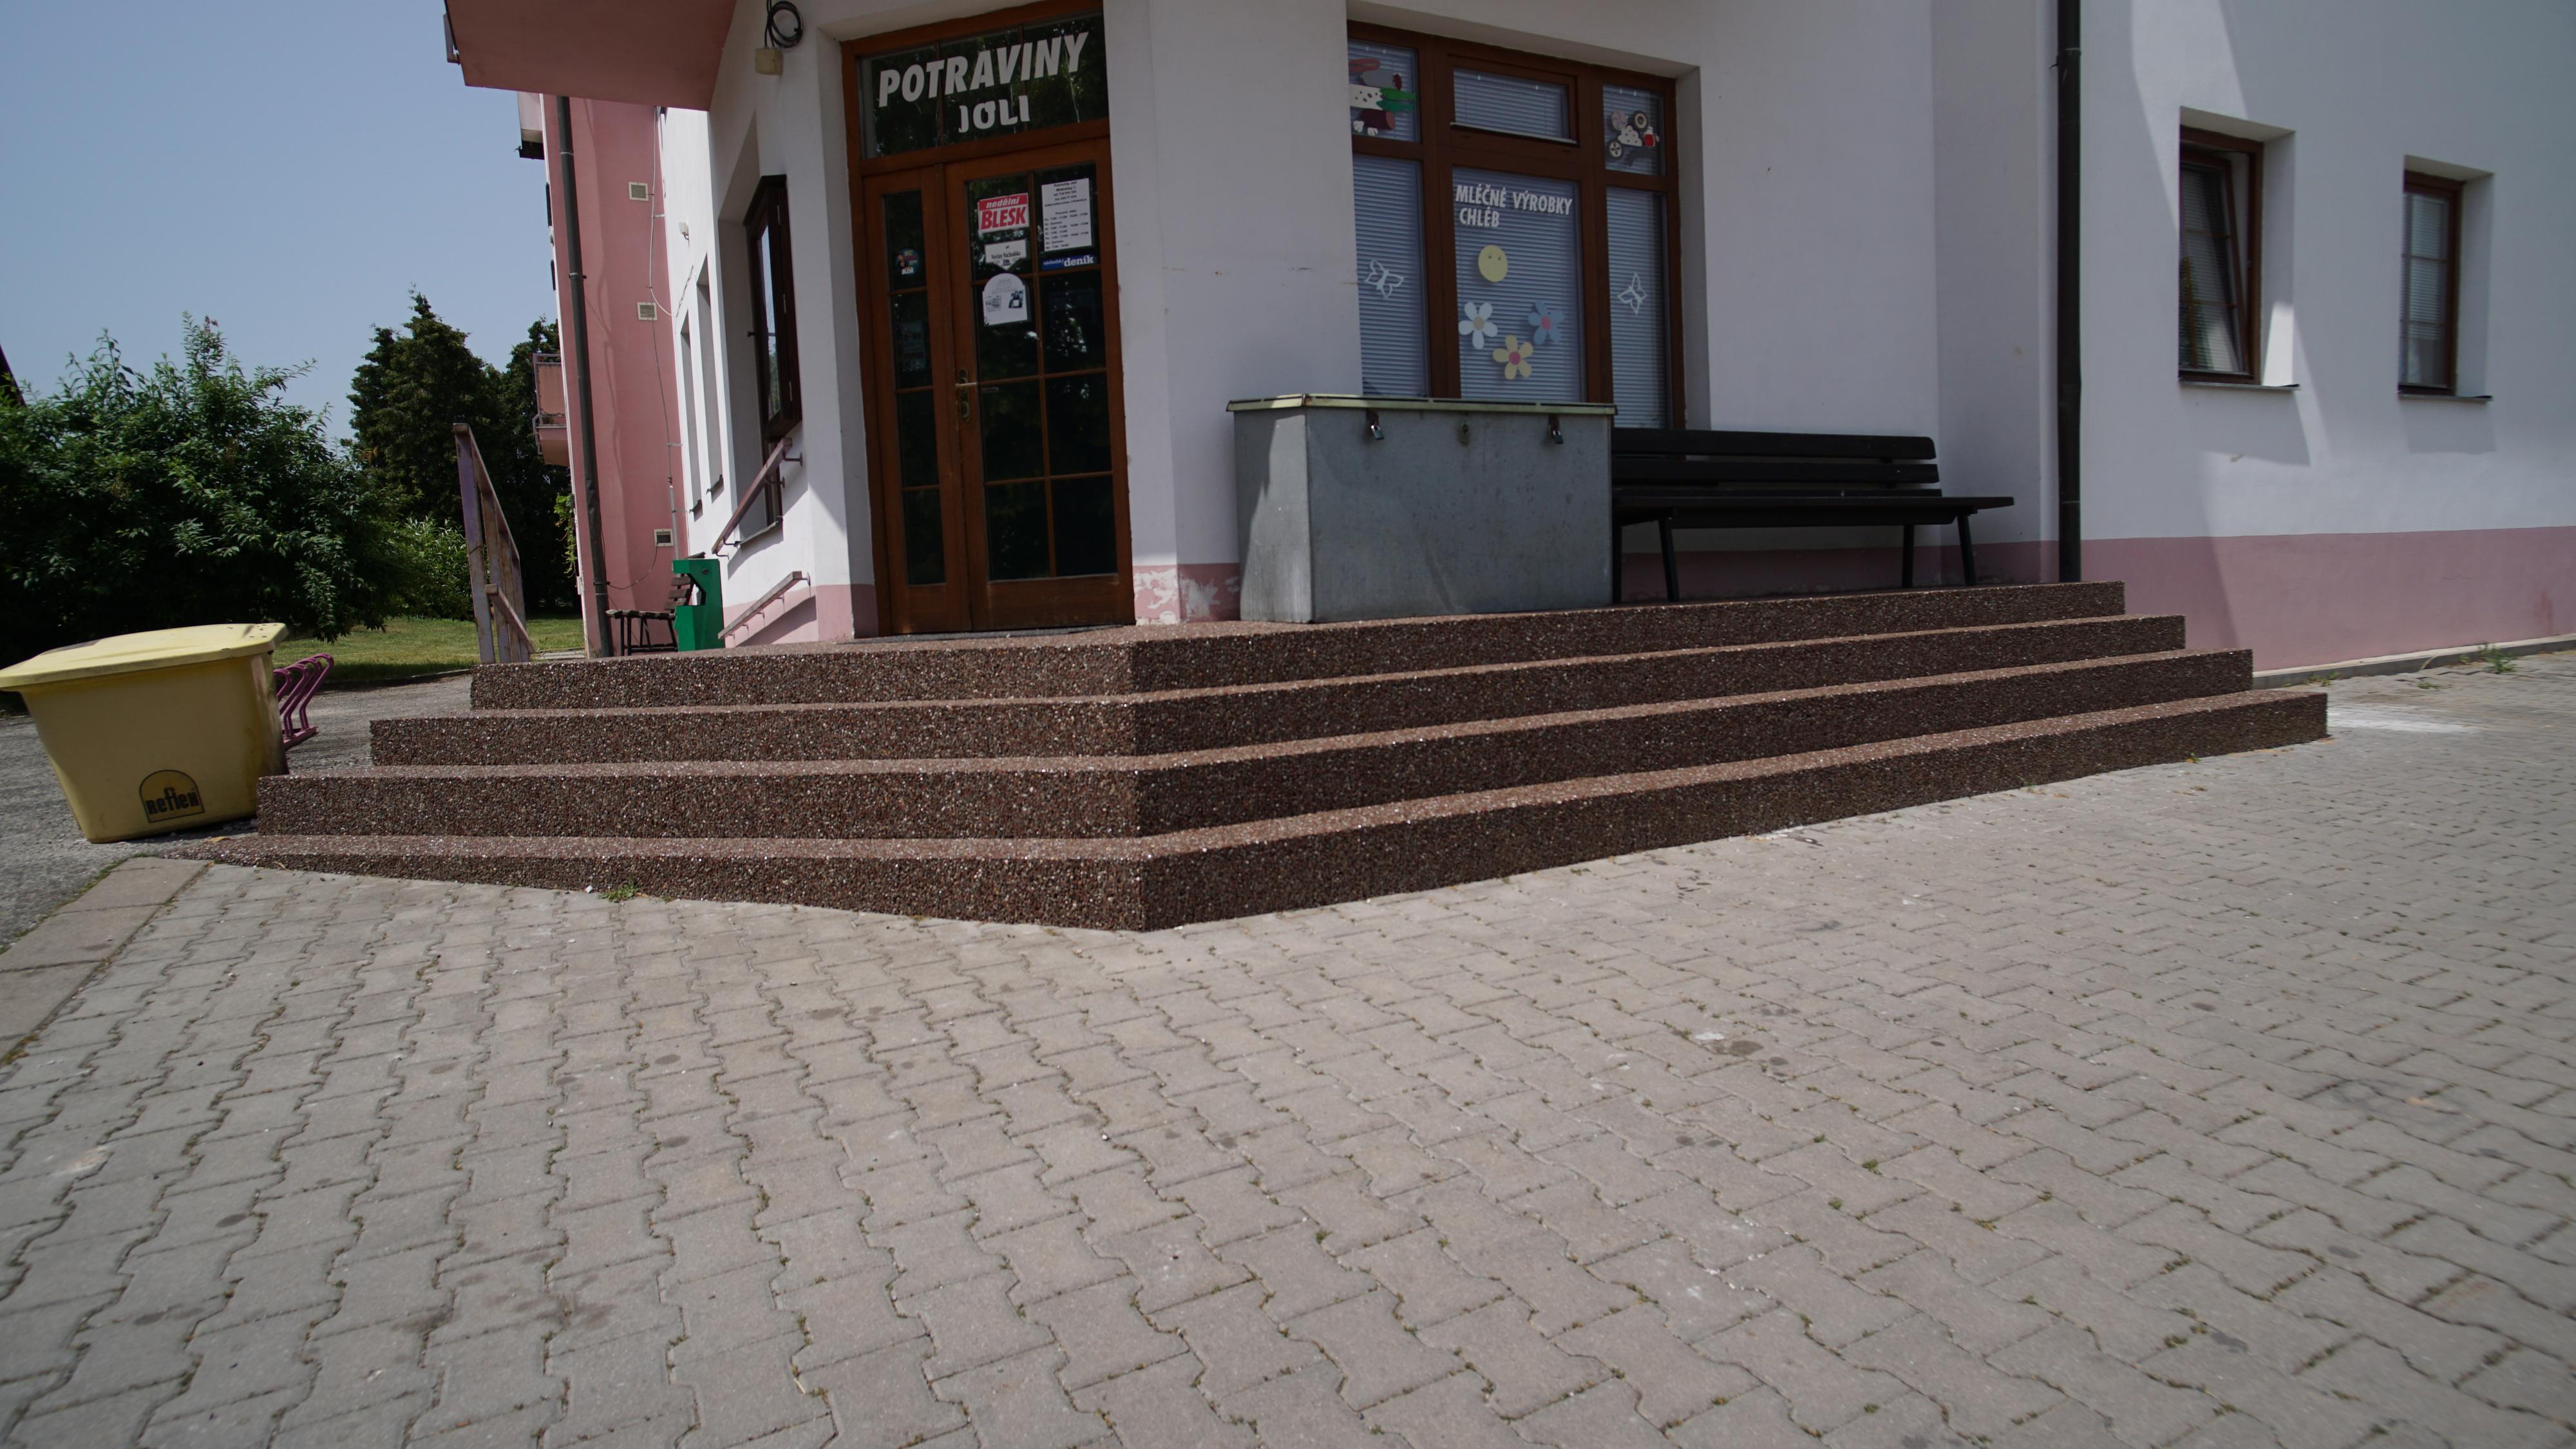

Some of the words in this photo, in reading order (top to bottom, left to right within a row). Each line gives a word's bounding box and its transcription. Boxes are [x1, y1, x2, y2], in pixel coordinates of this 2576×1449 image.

[878, 32, 1088, 108] POTRAVINY
[958, 95, 1030, 133] JOLI
[986, 196, 1020, 209] nedělní
[1455, 184, 1507, 208] MLÉČNÉ
[1513, 190, 1573, 215] VÝROBKY
[981, 206, 1027, 230] BLESK
[1459, 206, 1500, 227] CHLÉB
[1064, 254, 1094, 267] deník
